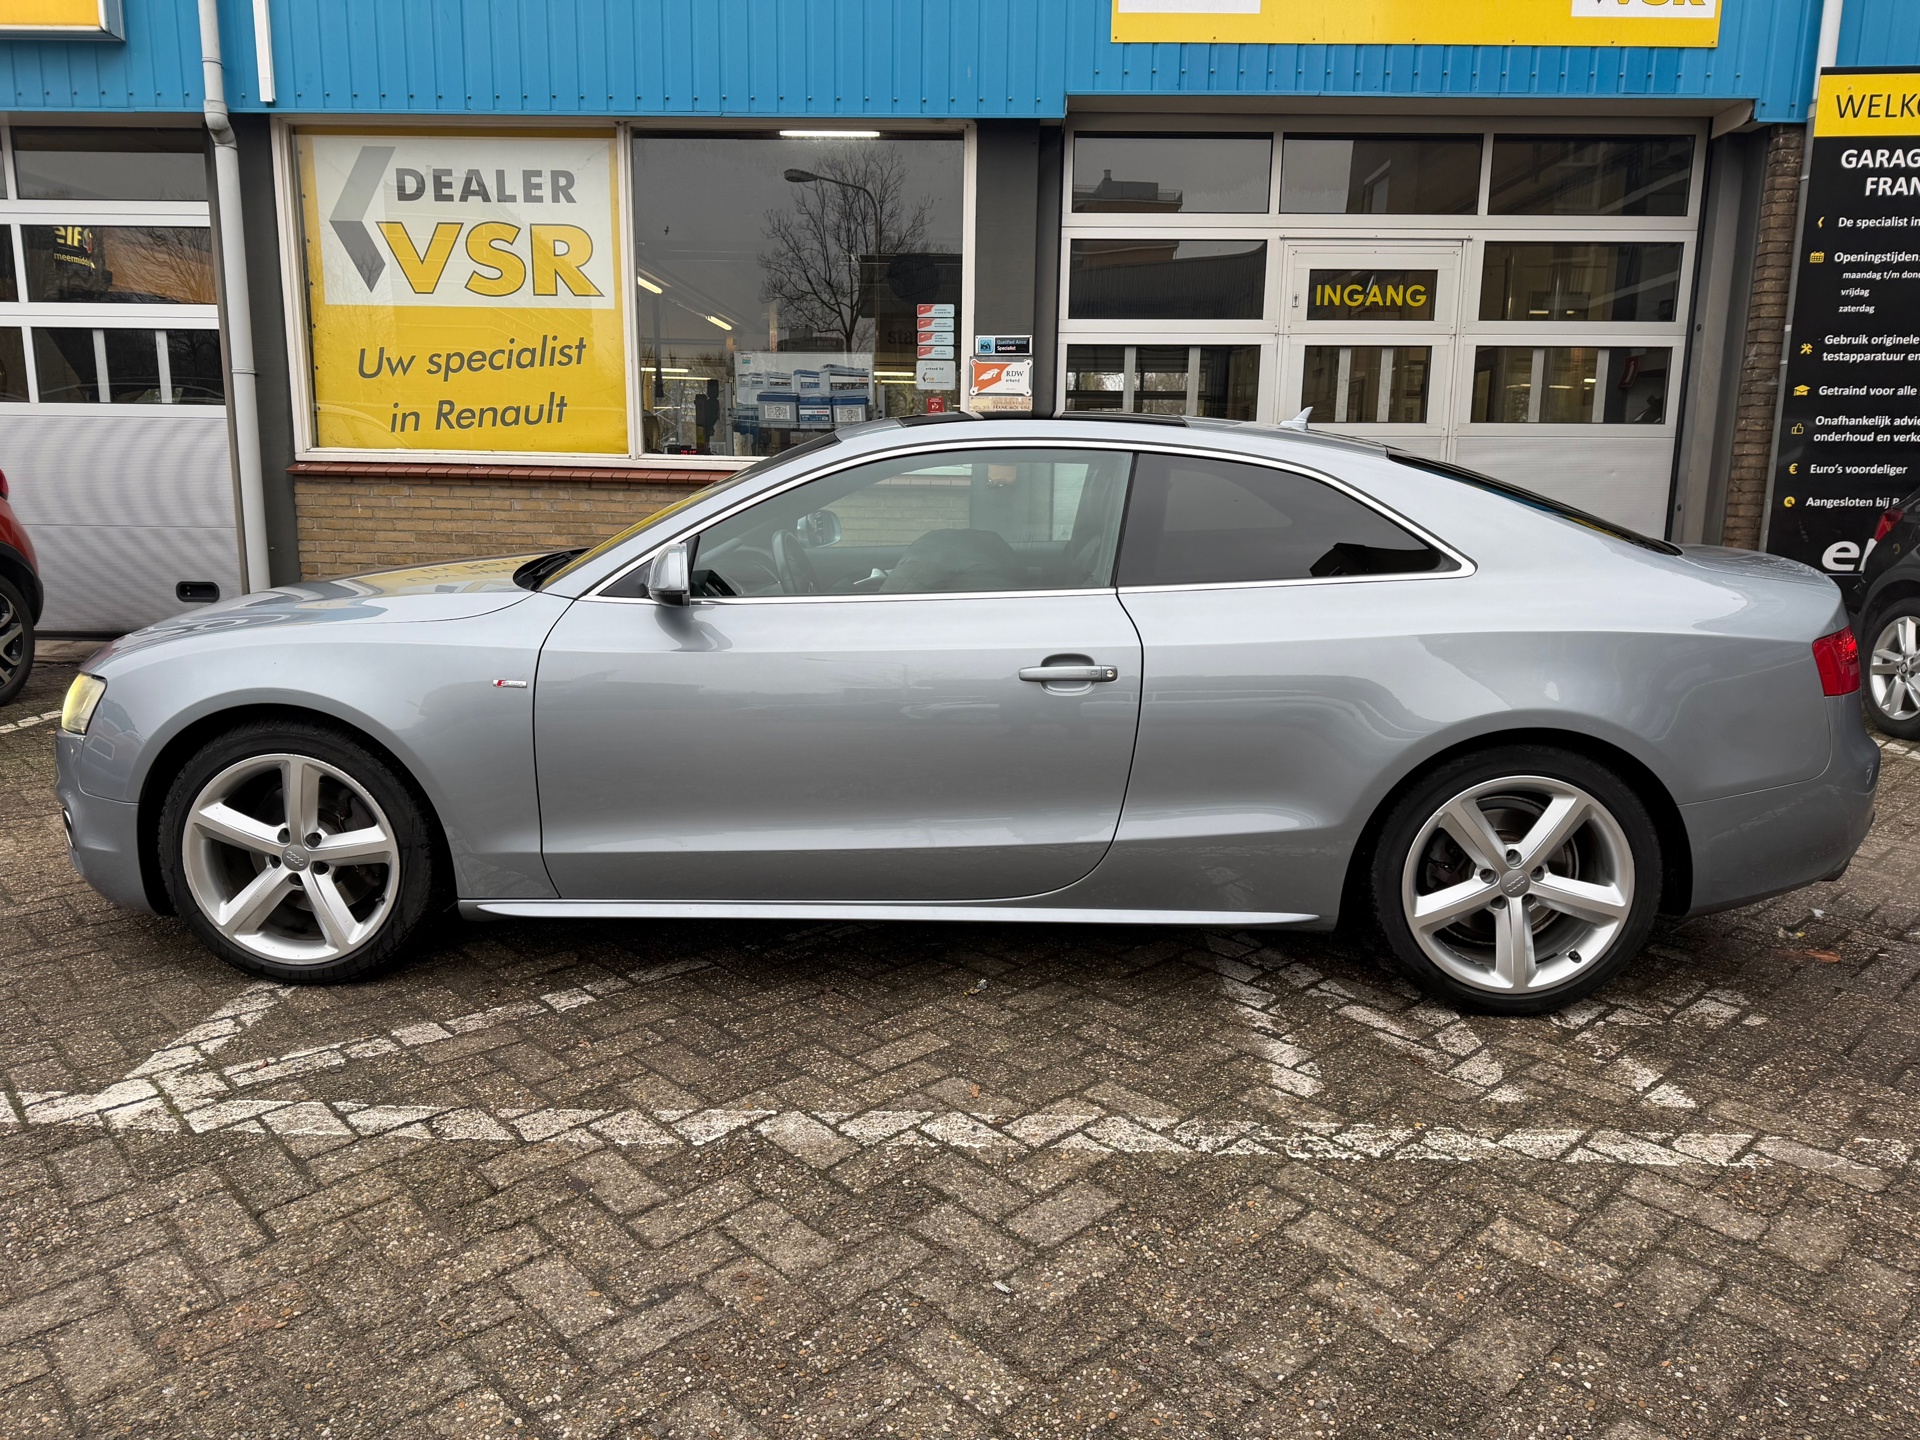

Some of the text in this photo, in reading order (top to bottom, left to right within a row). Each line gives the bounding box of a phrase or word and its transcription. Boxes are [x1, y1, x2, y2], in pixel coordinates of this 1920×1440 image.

[1836, 93, 1920, 118] WELK
[1841, 148, 1920, 169] GARAG
[395, 167, 577, 203] DEALER
[1838, 217, 1854, 227] De
[1856, 216, 1908, 229] specialist
[375, 221, 605, 297] VSR
[1842, 270, 1882, 280] maandag
[1883, 270, 1900, 280] t/m
[1315, 284, 1427, 307] INGANG
[1841, 288, 1870, 297] vrijdag
[1838, 304, 1875, 314] zaterdag
[1825, 334, 1920, 347] Gebruik originele
[358, 335, 587, 382] Uw specialist
[1822, 352, 1906, 364] testapparatuur
[1819, 385, 1917, 396] Getraind voor alle
[390, 391, 567, 433] in Renault
[1815, 415, 1892, 428] Onafhankelijk
[1813, 432, 1875, 442] onderhoud
[1877, 433, 1891, 442] en
[1810, 463, 1844, 475] Euro's
[1845, 463, 1909, 477] voordeliger
[1805, 497, 1874, 509] Aangesloten
[1875, 497, 1891, 509] bij
